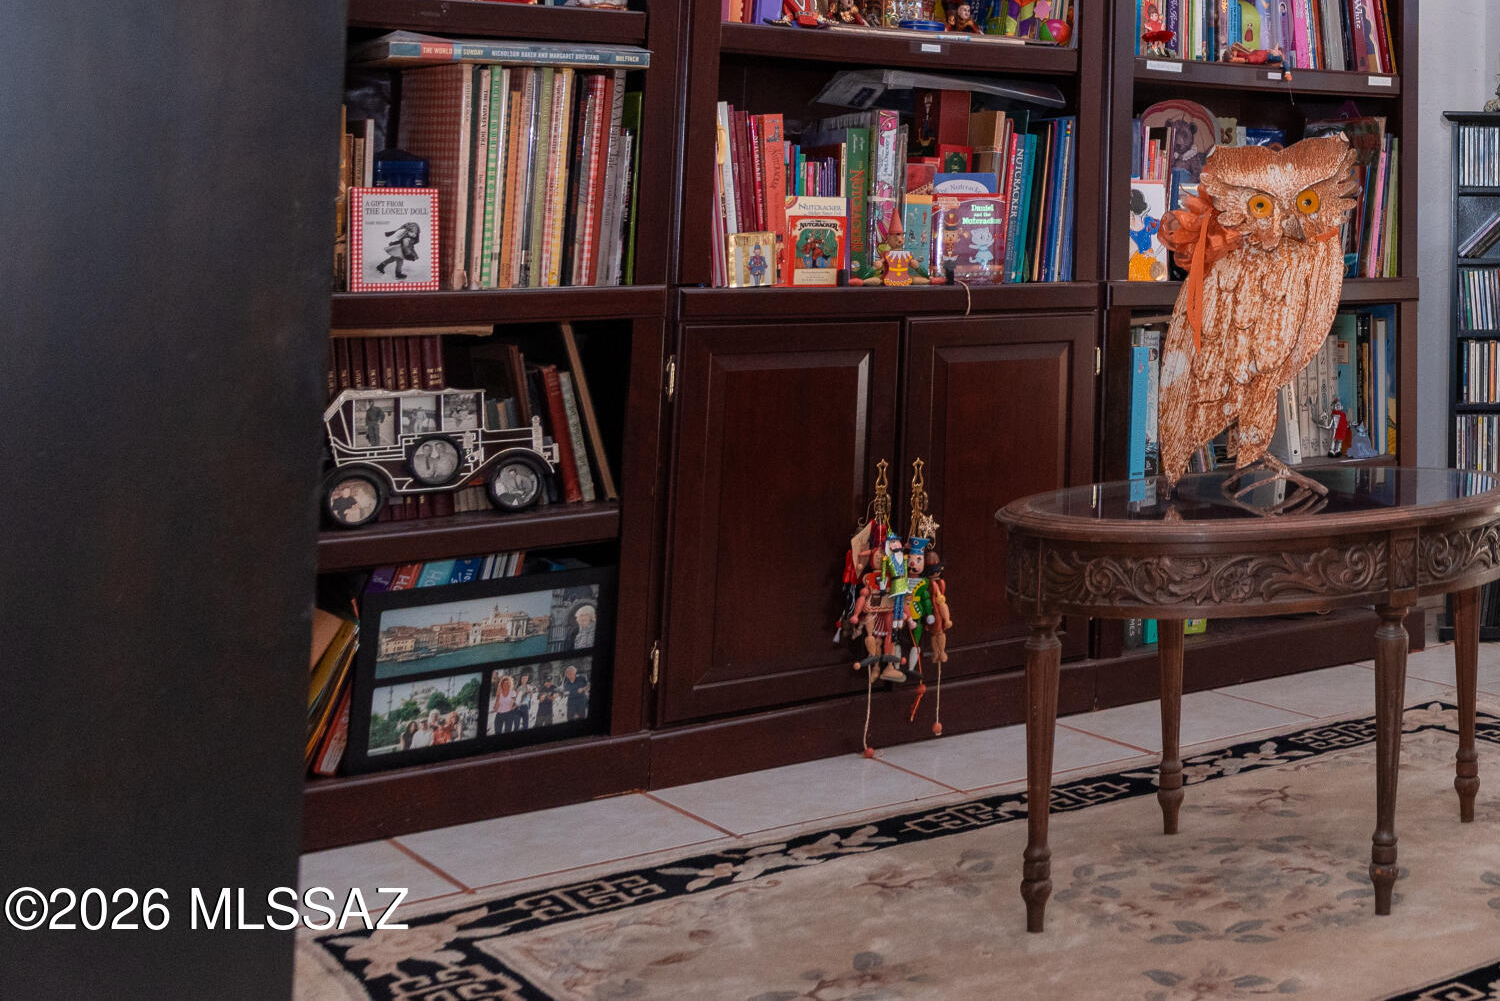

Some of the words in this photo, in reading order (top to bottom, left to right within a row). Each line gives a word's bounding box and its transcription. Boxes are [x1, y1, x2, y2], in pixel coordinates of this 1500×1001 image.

[423, 46, 433, 54] THE
[434, 47, 452, 55] WORLD
[492, 50, 519, 58] NICHOLSON
[616, 54, 639, 62] BULFINCH
[613, 77, 626, 110] LONA
[1009, 148, 1024, 217] NUTCRACKER
[382, 208, 408, 216] LONELY
[410, 208, 428, 216] DOLL
[798, 203, 842, 213] NUTCRACKER
[850, 169, 865, 252] NUTCRACKER
[971, 204, 994, 212] Daniel
[962, 216, 1002, 225] Nutcracker
[798, 222, 839, 232] NUTCRACKER
